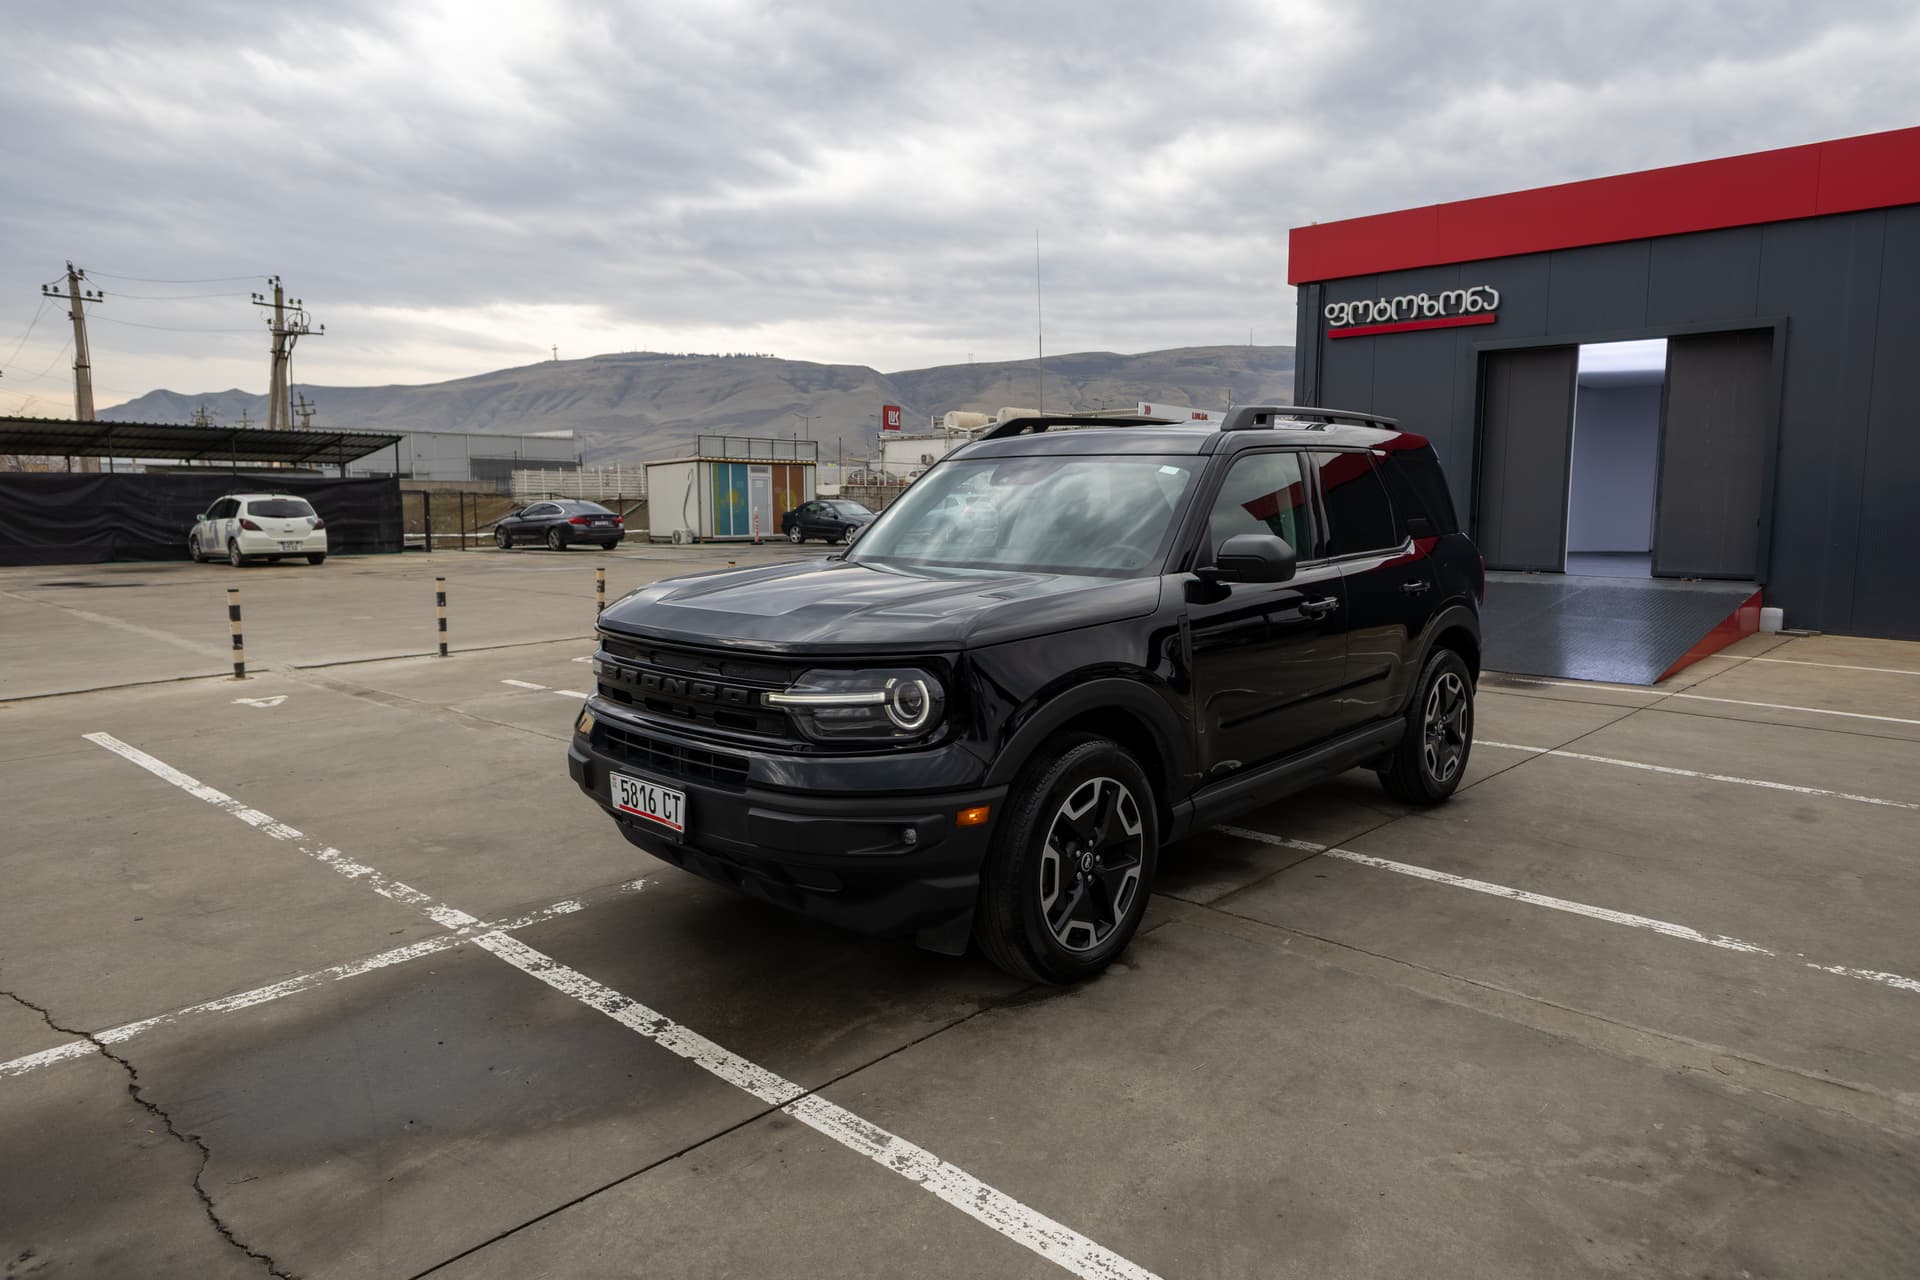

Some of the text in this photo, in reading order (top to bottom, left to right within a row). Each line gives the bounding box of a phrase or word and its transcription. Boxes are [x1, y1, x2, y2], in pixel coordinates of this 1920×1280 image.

[1324, 285, 1500, 327] ფოტოზონა
[620, 779, 681, 824] 5816 CT
